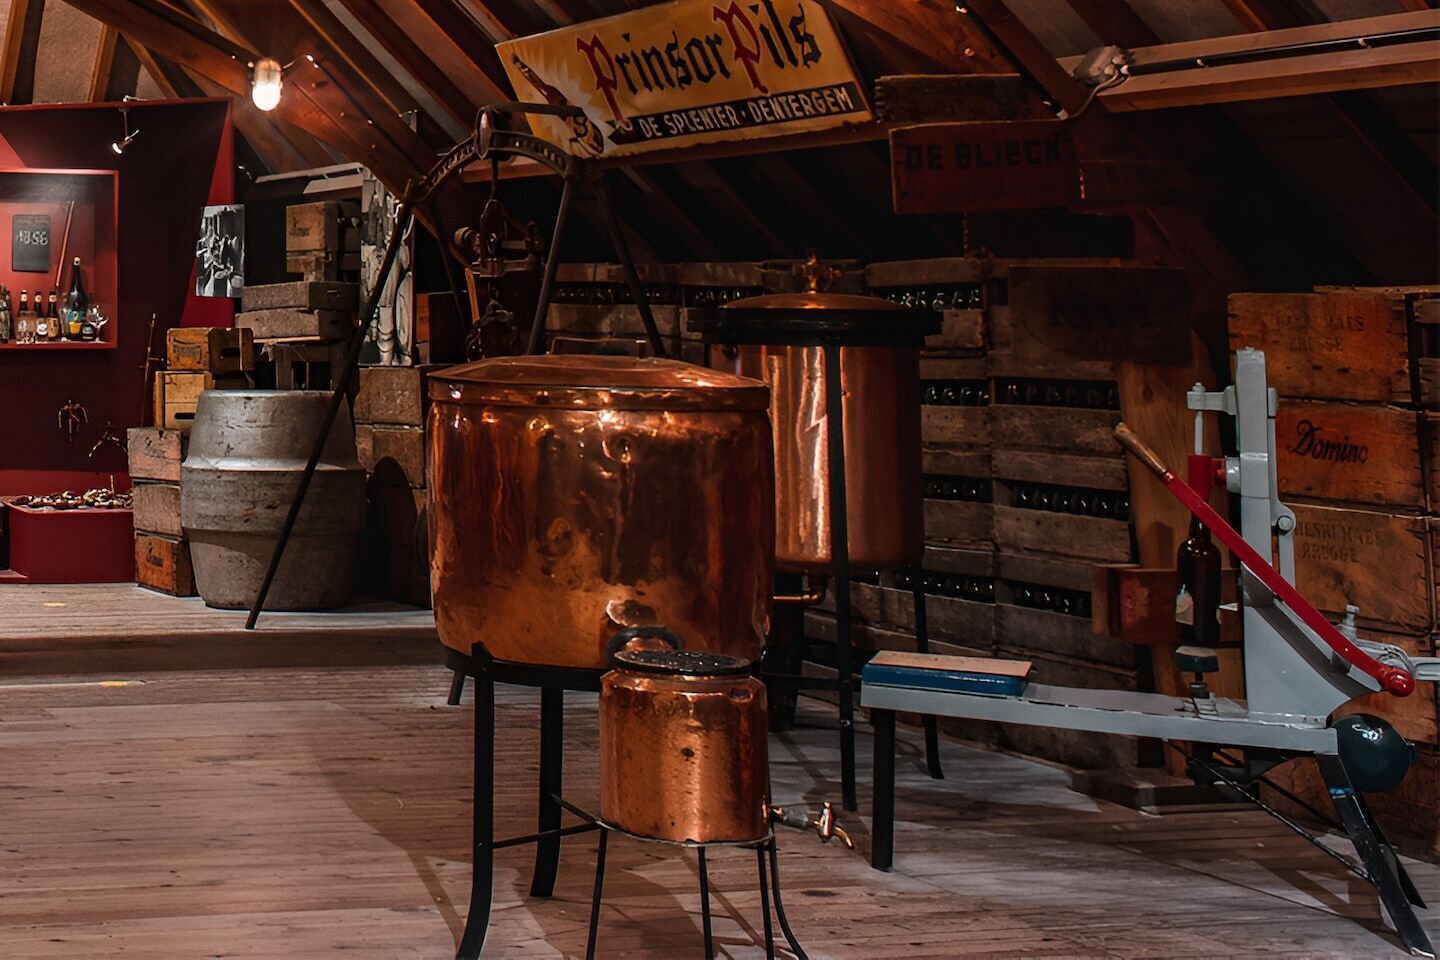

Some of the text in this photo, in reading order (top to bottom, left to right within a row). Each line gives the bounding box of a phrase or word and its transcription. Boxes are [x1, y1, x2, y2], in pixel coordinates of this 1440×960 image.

[639, 85, 856, 139] DE SPLENTER DENTERGEM
[904, 143, 944, 172] DE
[1286, 419, 1369, 464] Domino
